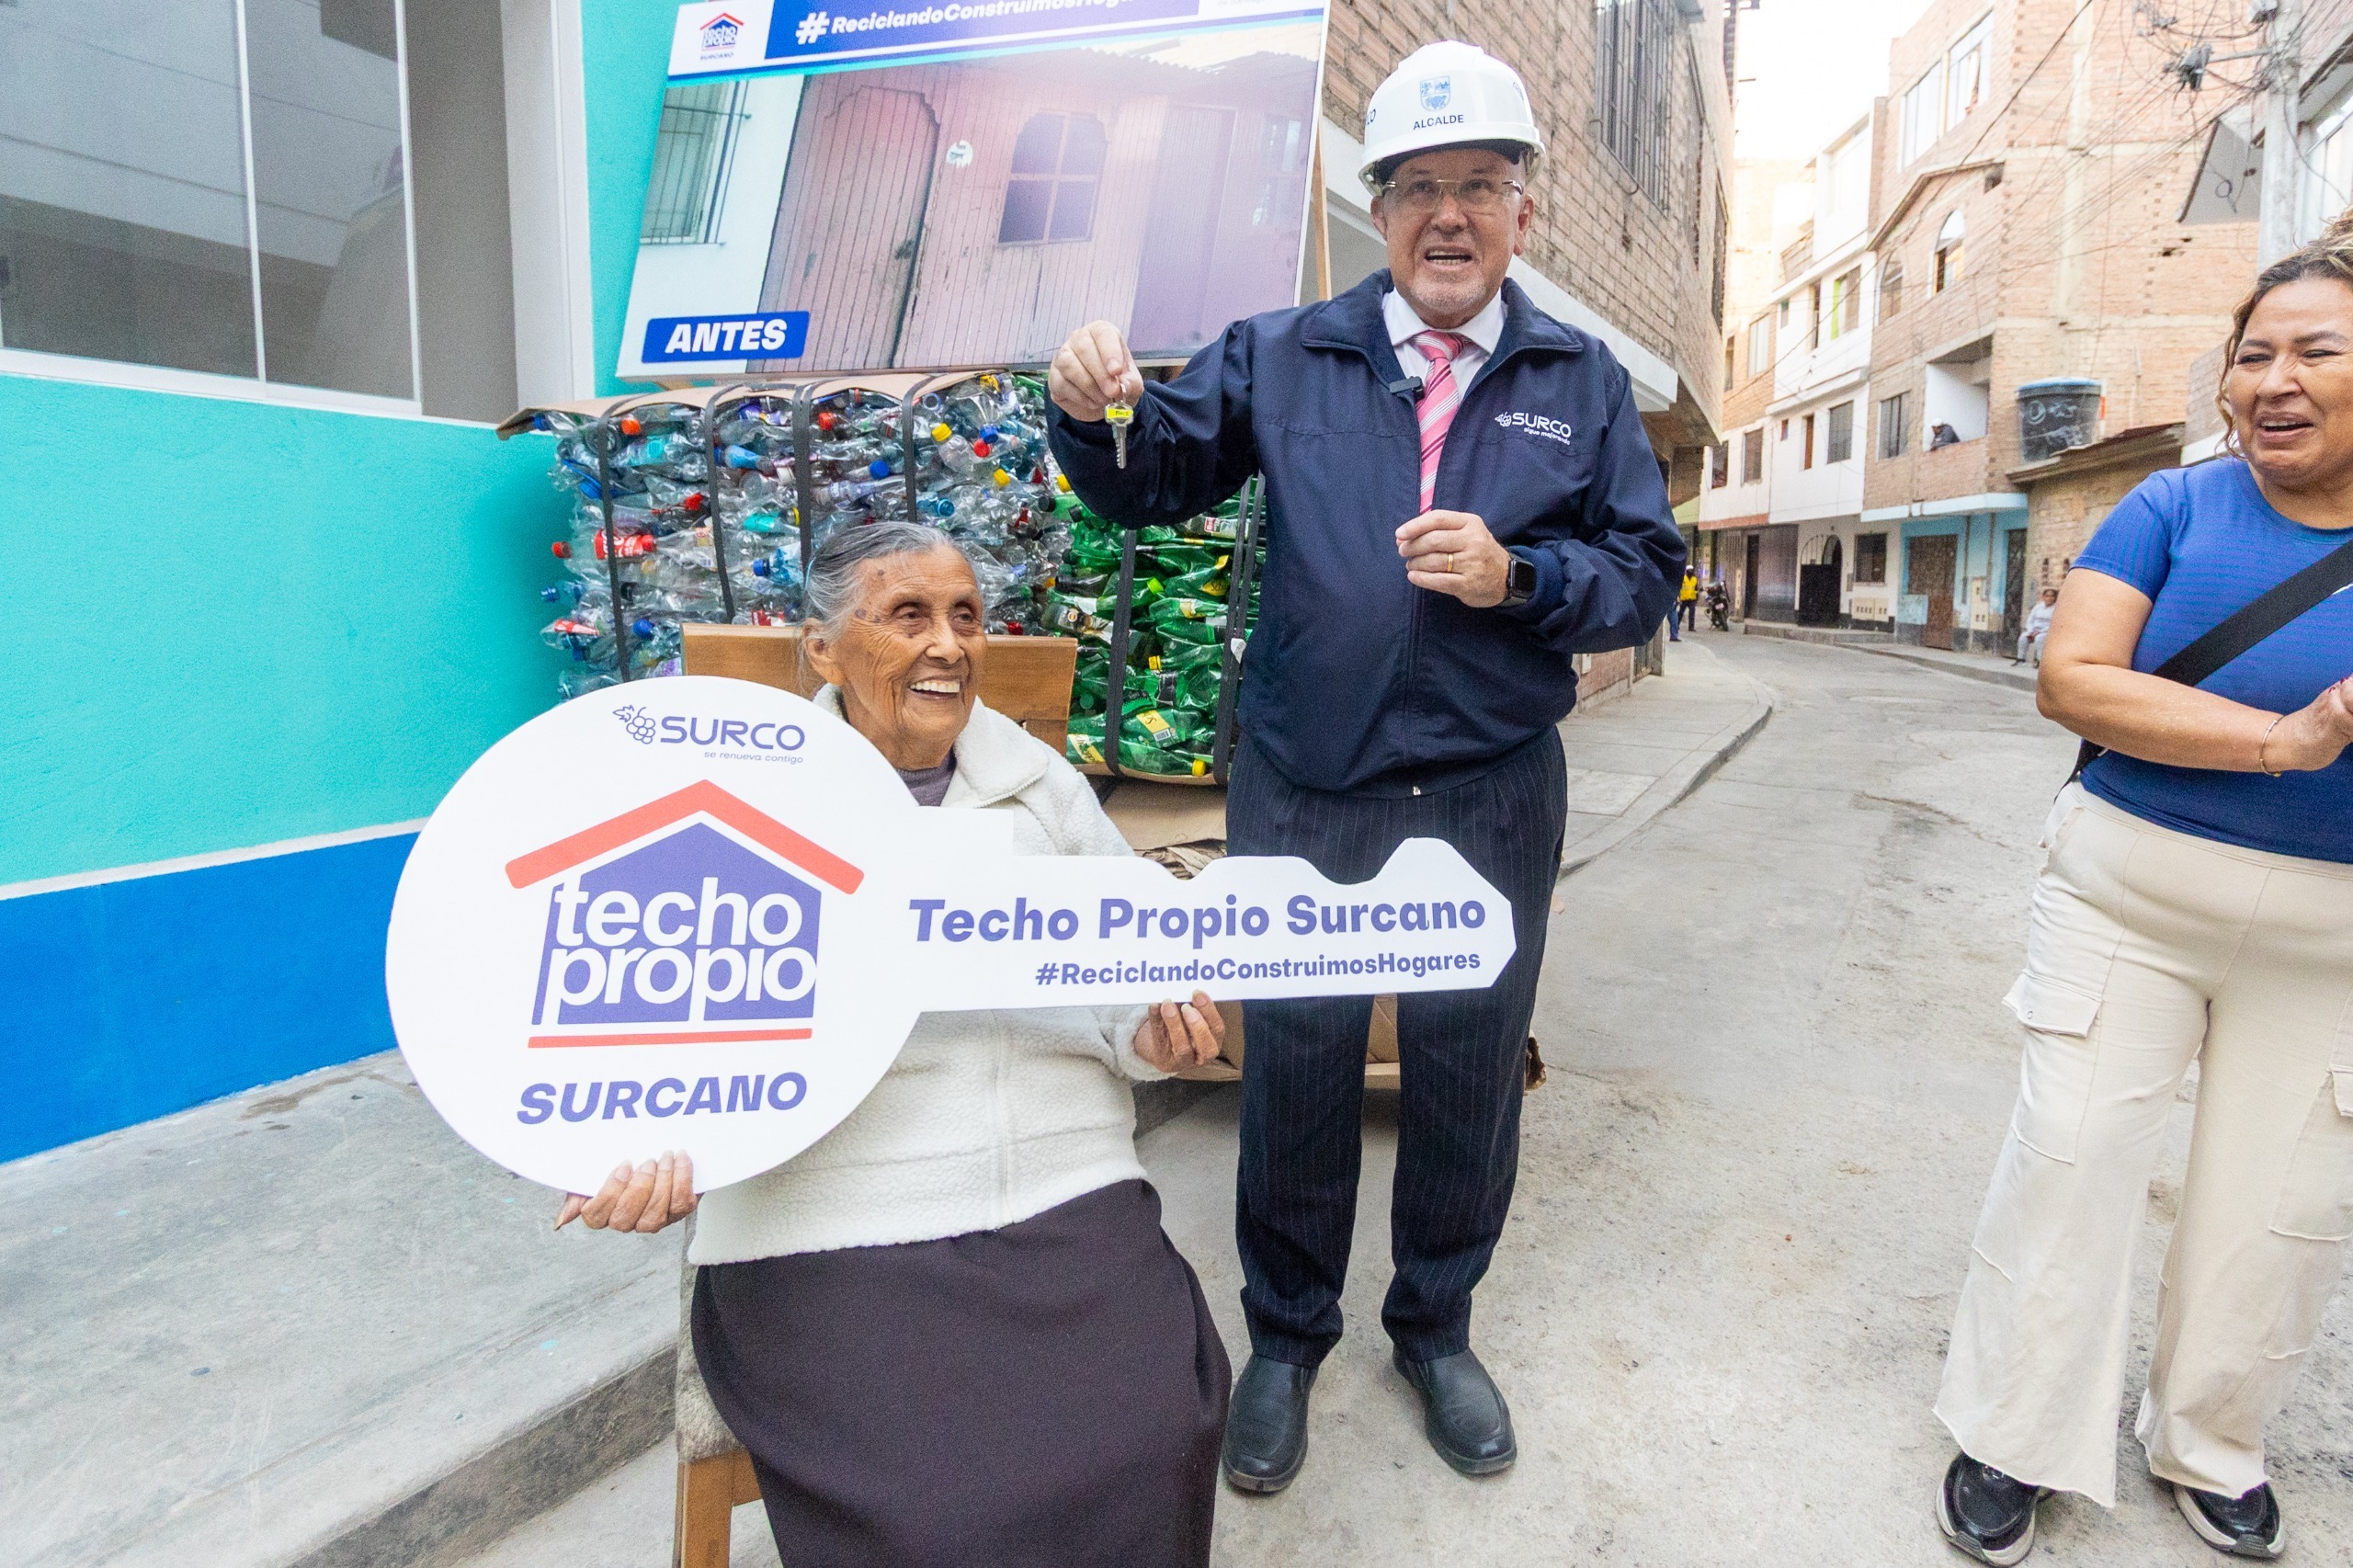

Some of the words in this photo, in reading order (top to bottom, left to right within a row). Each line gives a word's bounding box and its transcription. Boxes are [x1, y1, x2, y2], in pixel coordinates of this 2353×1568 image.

[795, 0, 1134, 45] #ReciclandoConstruimos
[1413, 114, 1464, 131] ALCALDE
[664, 319, 788, 354] ANTES
[1512, 412, 1572, 438] SURCO
[660, 715, 805, 751] SURCO
[720, 751, 762, 761] renueva
[765, 754, 803, 766] contigo
[554, 874, 802, 947] techo
[909, 897, 1079, 942] Techo
[1098, 894, 1269, 949] Propio
[1286, 894, 1486, 937] Surcano
[542, 948, 816, 1024] propio
[1035, 952, 1481, 986] #ReciclandoConstruimosHogares
[517, 1072, 808, 1125] SURCANO
